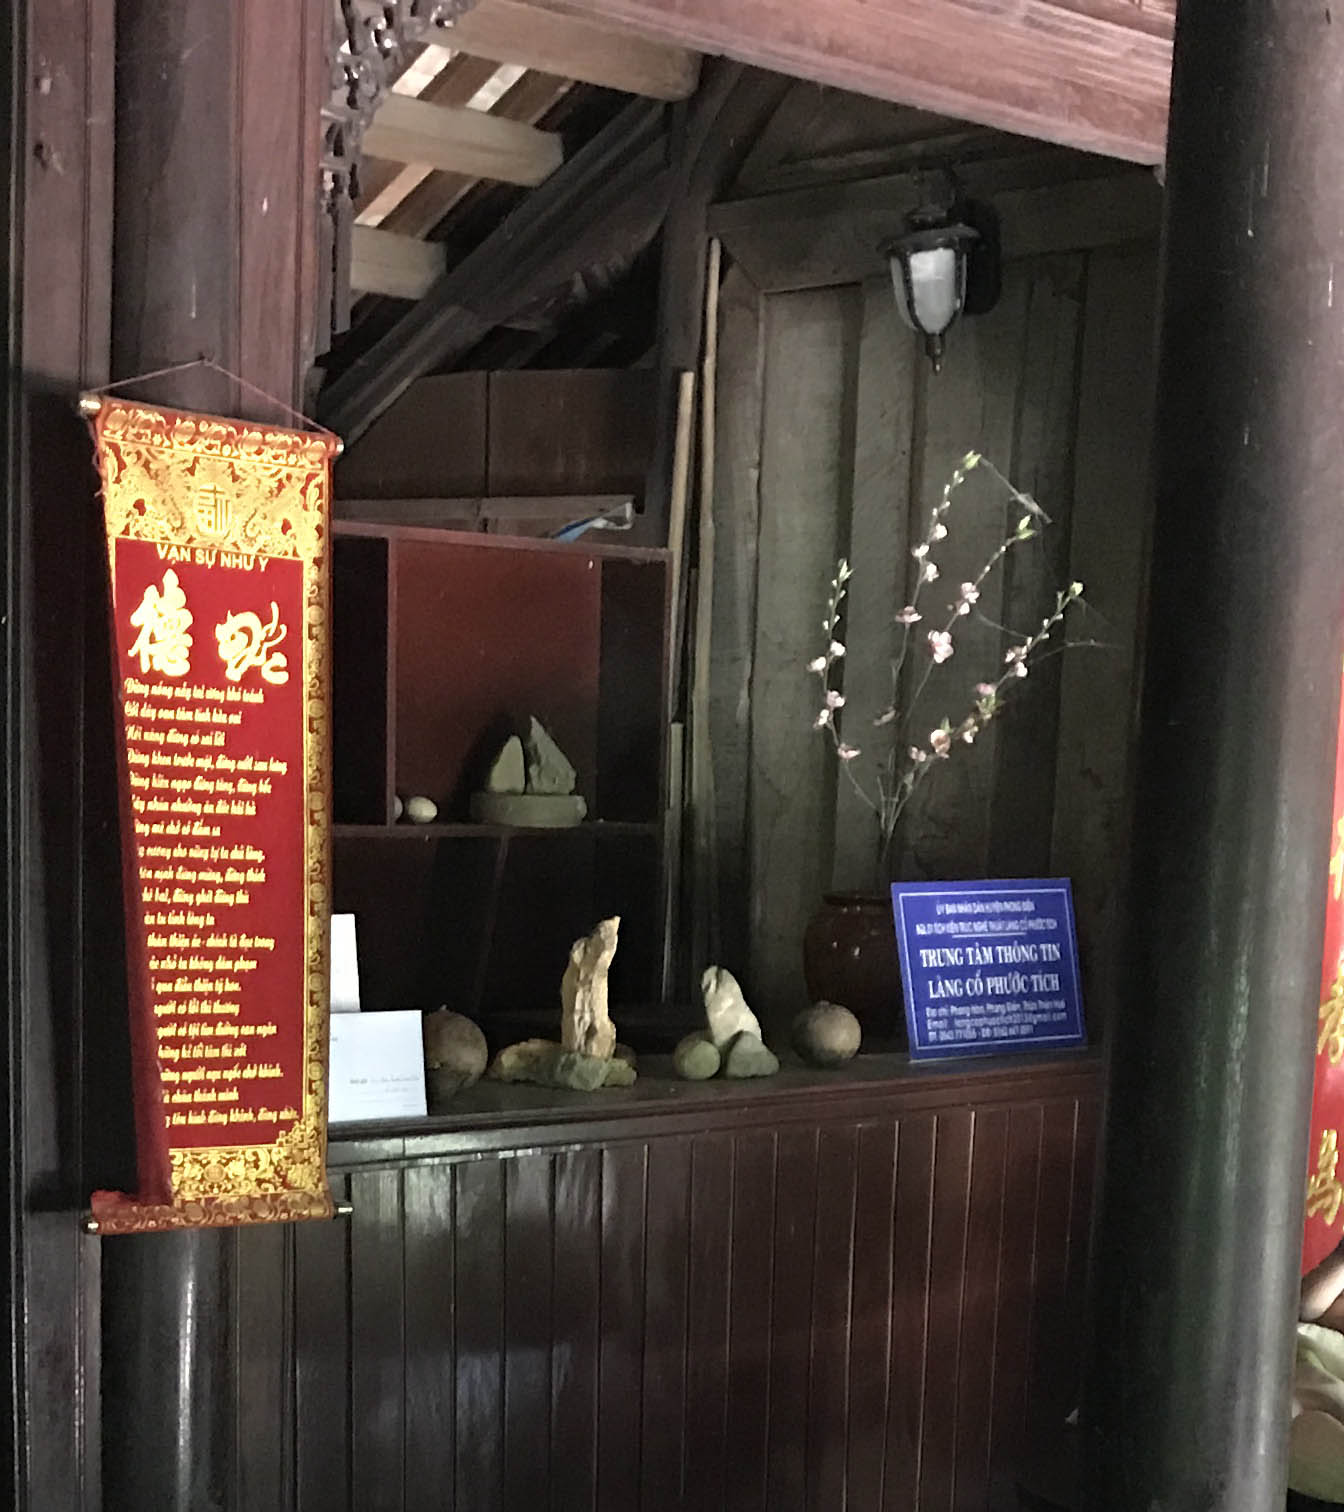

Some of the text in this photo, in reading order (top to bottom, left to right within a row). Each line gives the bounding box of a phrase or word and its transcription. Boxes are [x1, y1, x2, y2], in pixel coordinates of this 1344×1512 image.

[920, 940, 1061, 968] TRUNG TÂM THÔNG TIN
[928, 969, 1060, 999] LÀNG CỔ PHƯỚC TÍCH
